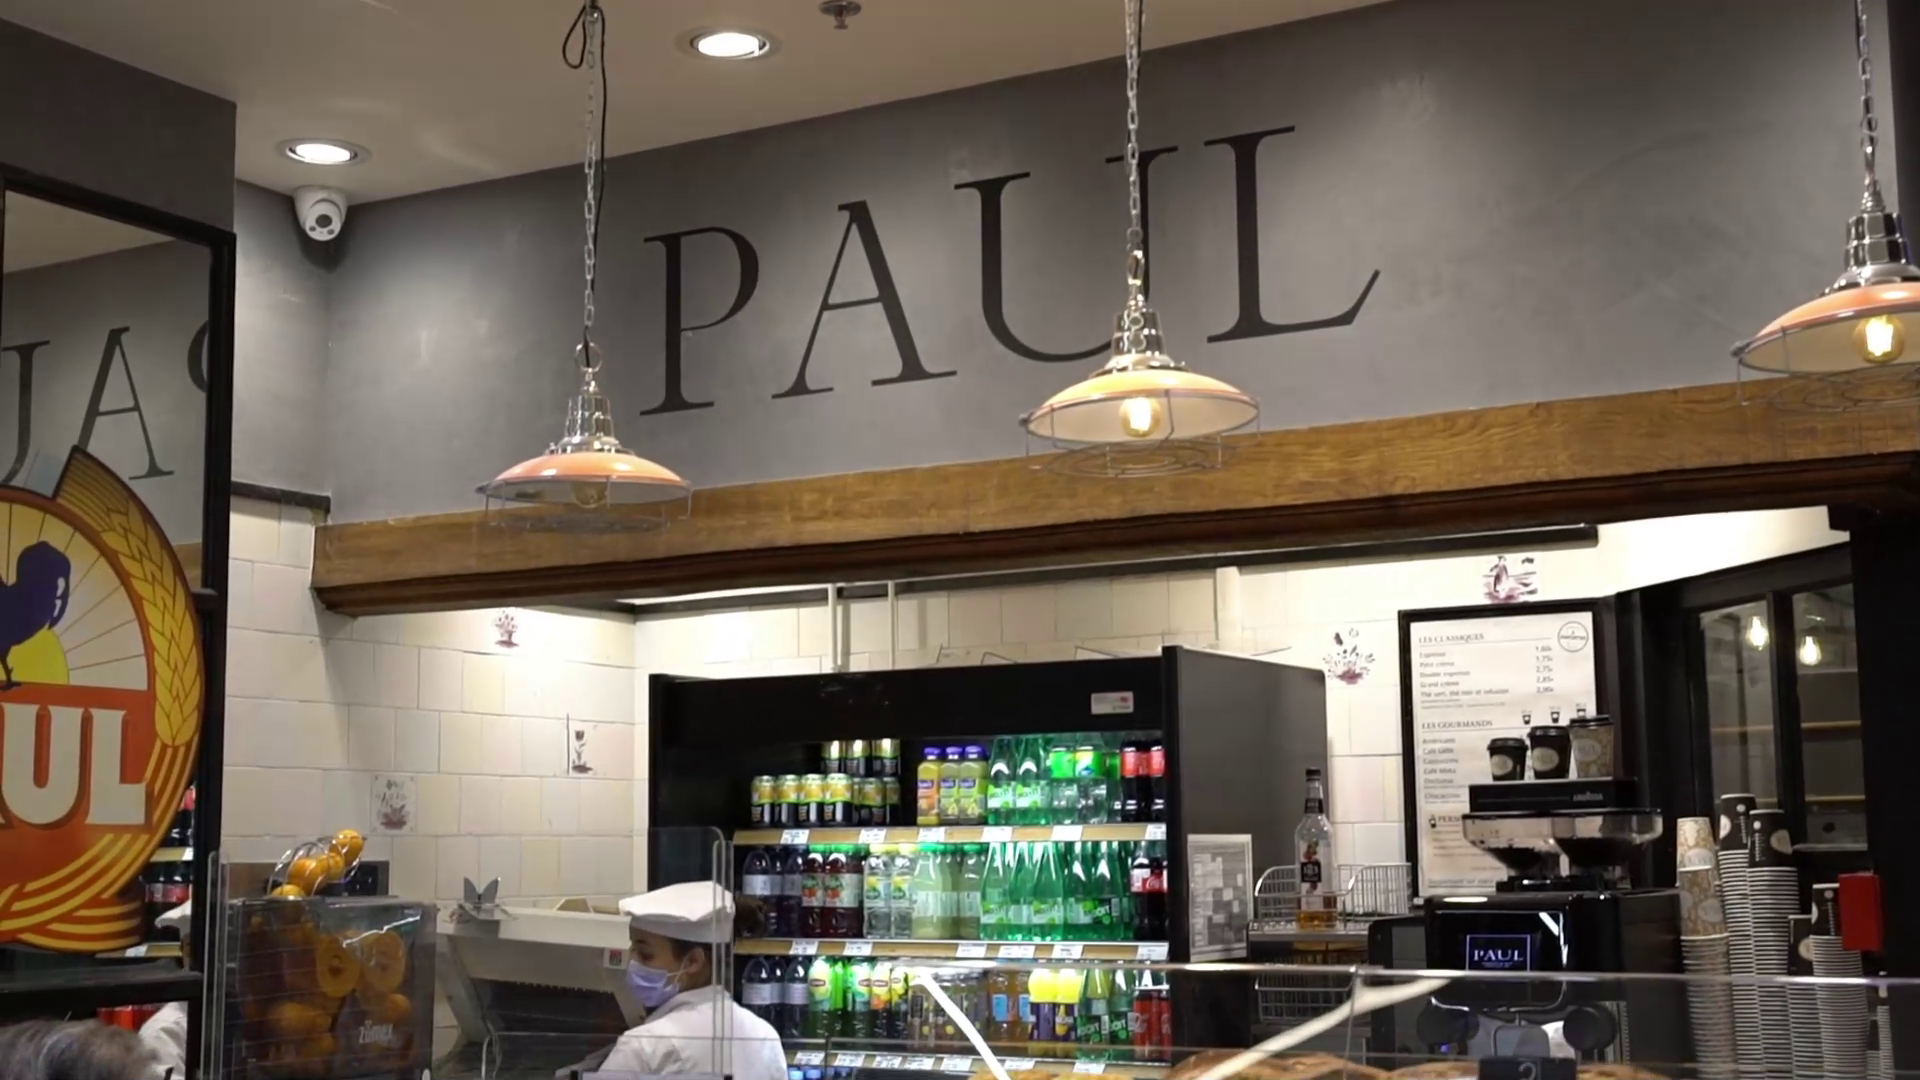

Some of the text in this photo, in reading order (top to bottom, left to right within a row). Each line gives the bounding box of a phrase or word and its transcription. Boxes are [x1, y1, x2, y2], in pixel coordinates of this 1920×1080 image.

[640, 125, 1380, 417] PAUL
[1437, 719, 1493, 729] GOURMANDS
[0, 703, 146, 825] UL
[1473, 949, 1524, 961] PAUL
